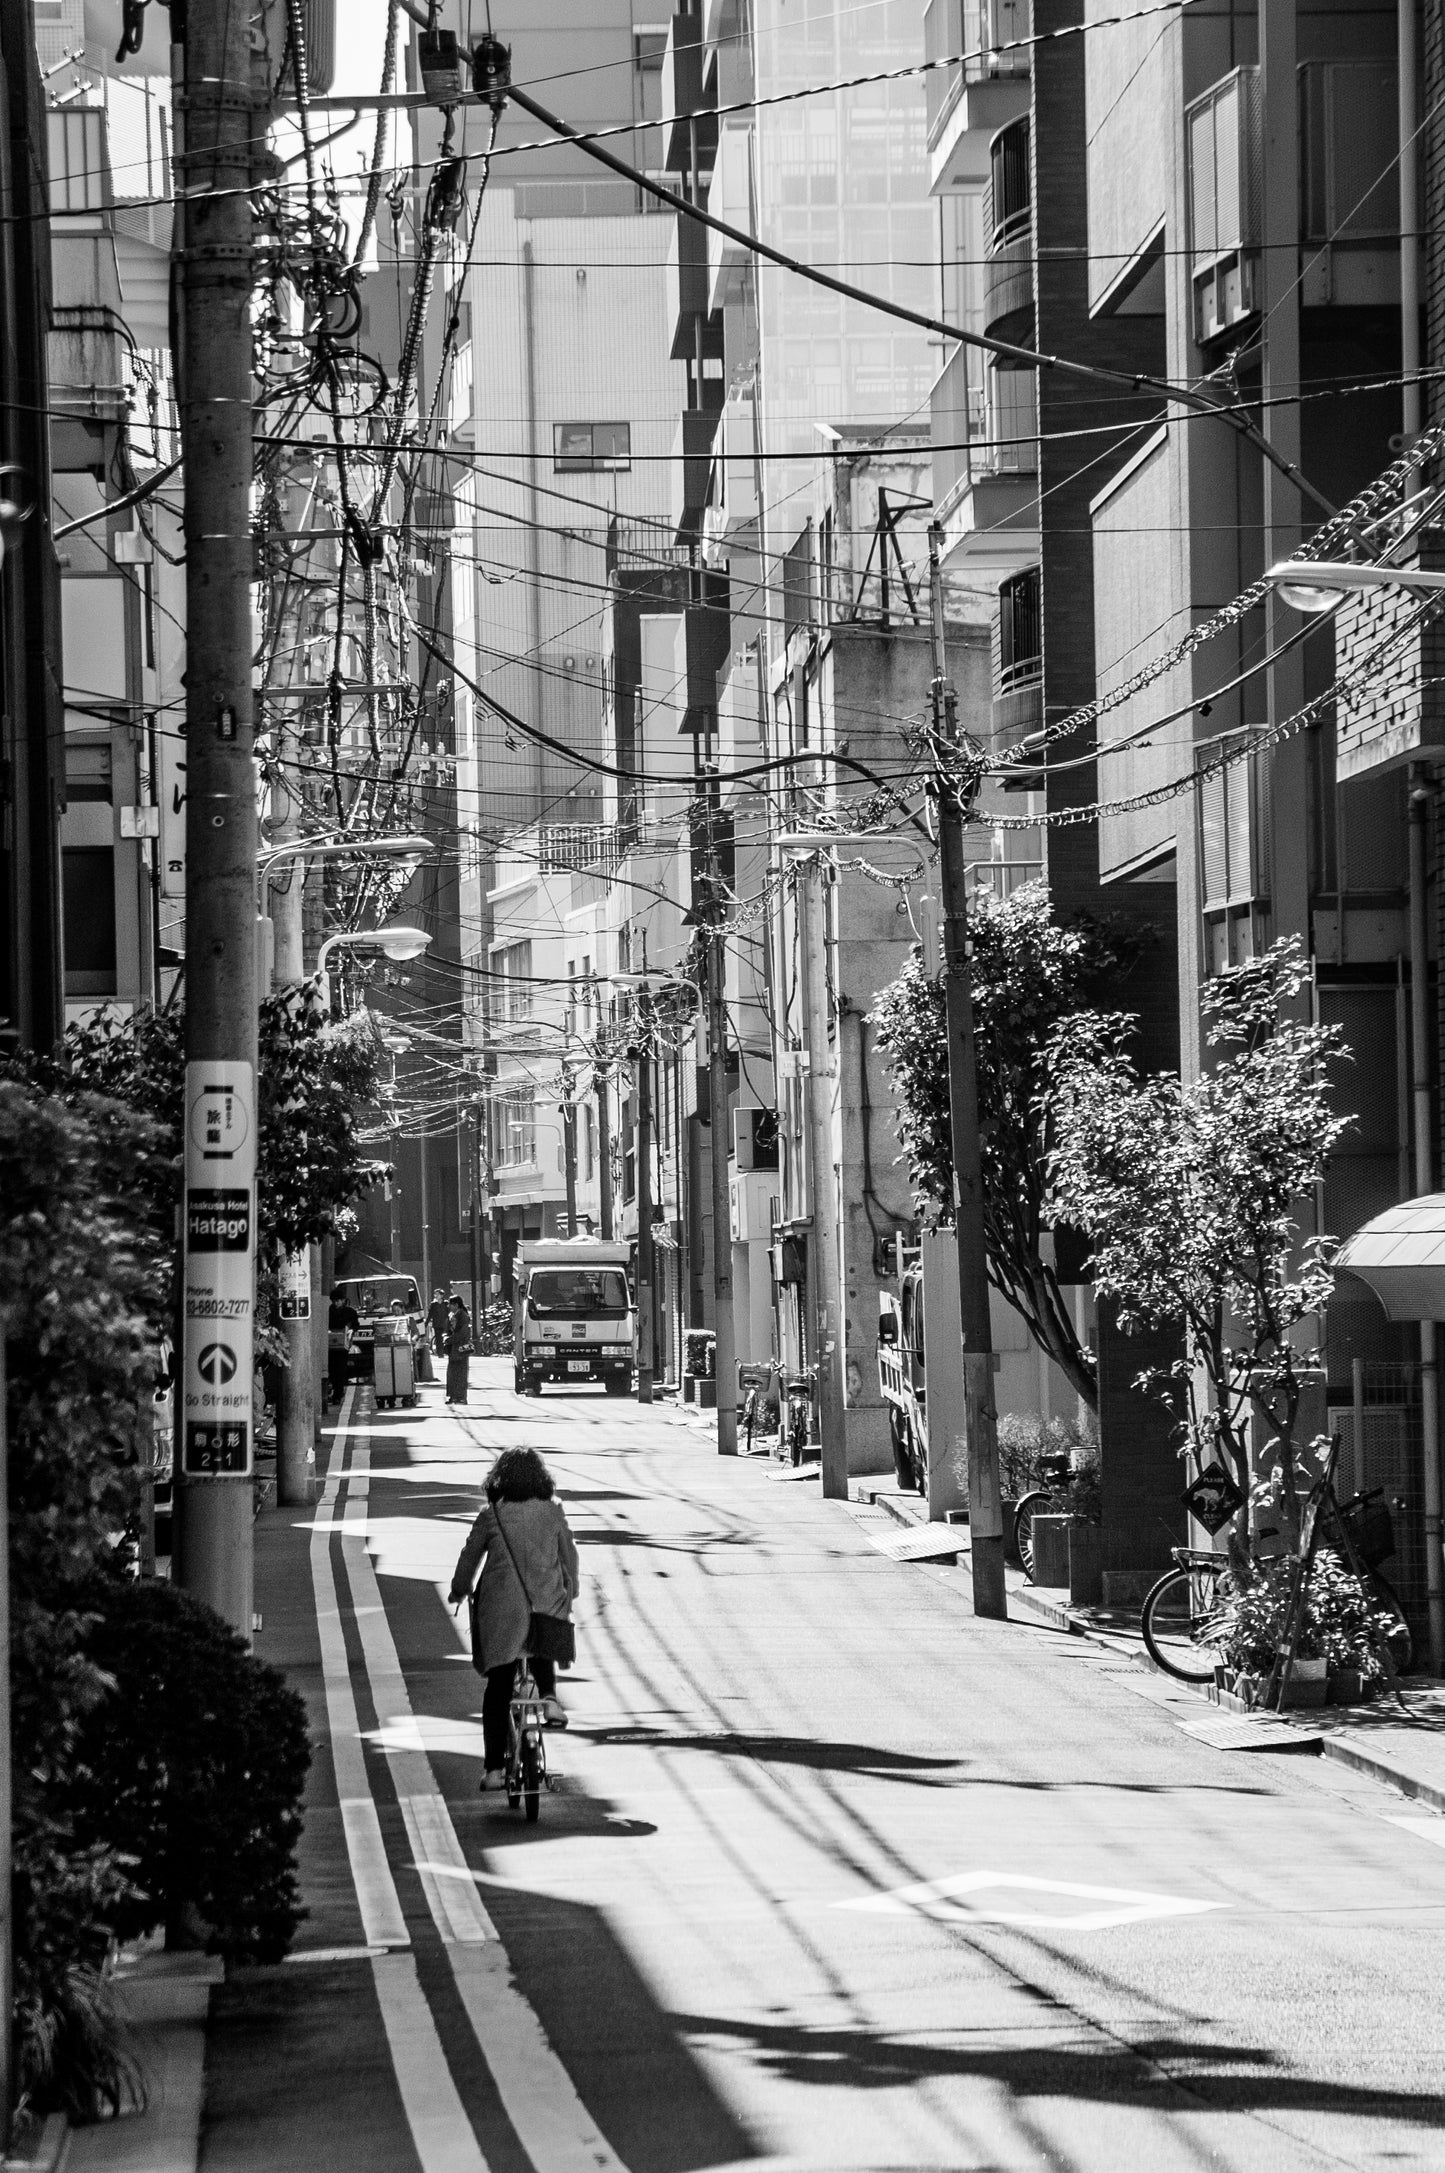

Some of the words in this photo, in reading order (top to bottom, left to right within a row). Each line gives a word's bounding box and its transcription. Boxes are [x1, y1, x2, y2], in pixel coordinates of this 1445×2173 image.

[188, 1200, 226, 1211] Asakusa
[227, 1200, 248, 1211] Hotel
[189, 1216, 247, 1239] Hatago
[186, 1286, 214, 1297] Phone
[186, 1300, 250, 1314] 03-6802-7277
[185, 1393, 200, 1407] Go
[202, 1393, 249, 1408] Straight
[201, 1452, 232, 1467] 2-1
